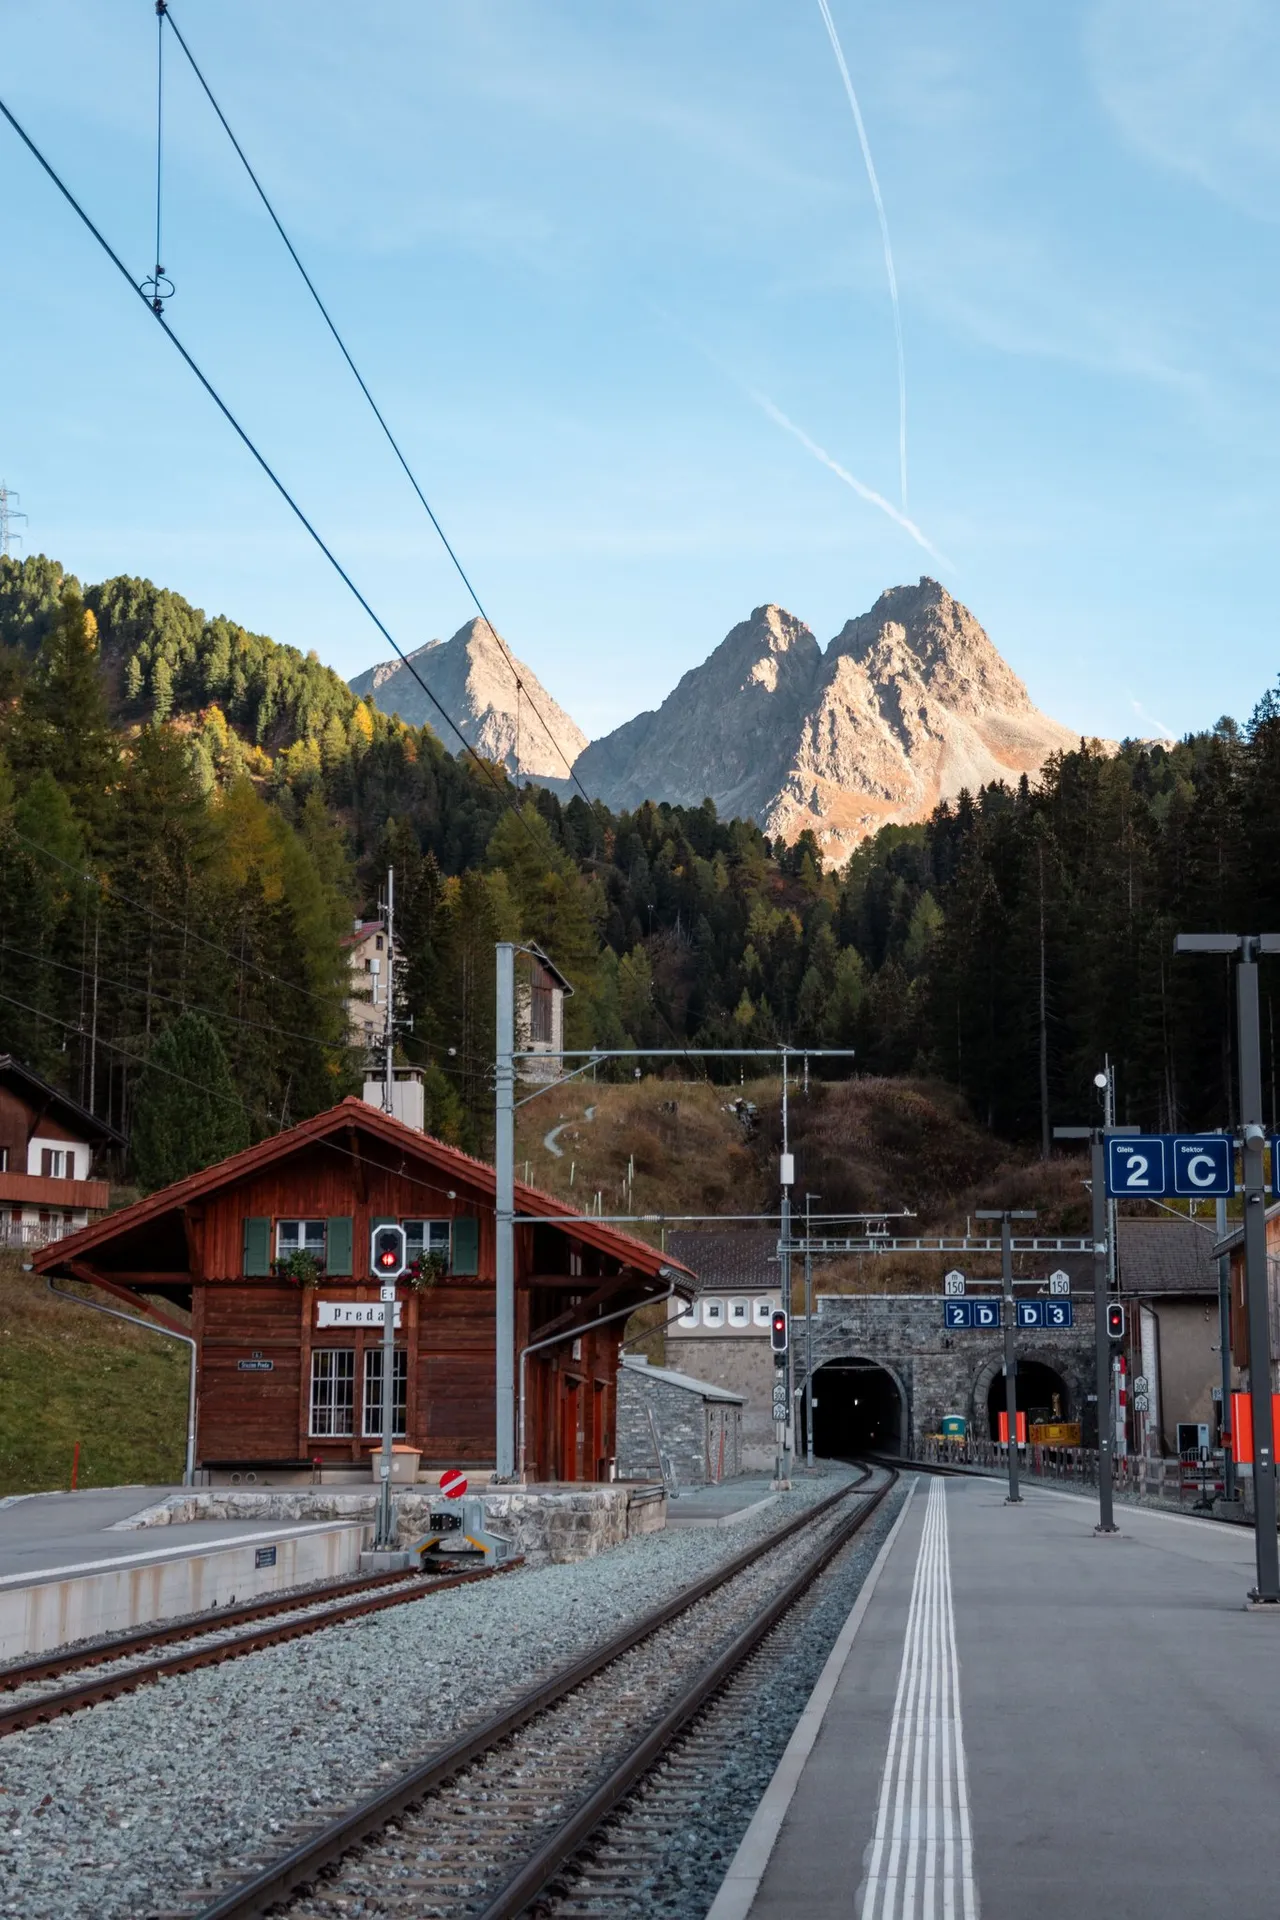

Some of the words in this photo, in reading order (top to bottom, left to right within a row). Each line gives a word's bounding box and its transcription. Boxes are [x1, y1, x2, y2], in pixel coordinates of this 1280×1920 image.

[1126, 1155, 1149, 1187] 2
[1187, 1155, 1217, 1187] C
[947, 1281, 964, 1294] 150
[1052, 1280, 1069, 1293] 150
[333, 1308, 384, 1321] Preda
[953, 1309, 964, 1324] 2
[980, 1309, 993, 1324] D
[1024, 1309, 1037, 1324] D
[1053, 1308, 1064, 1324] 3
